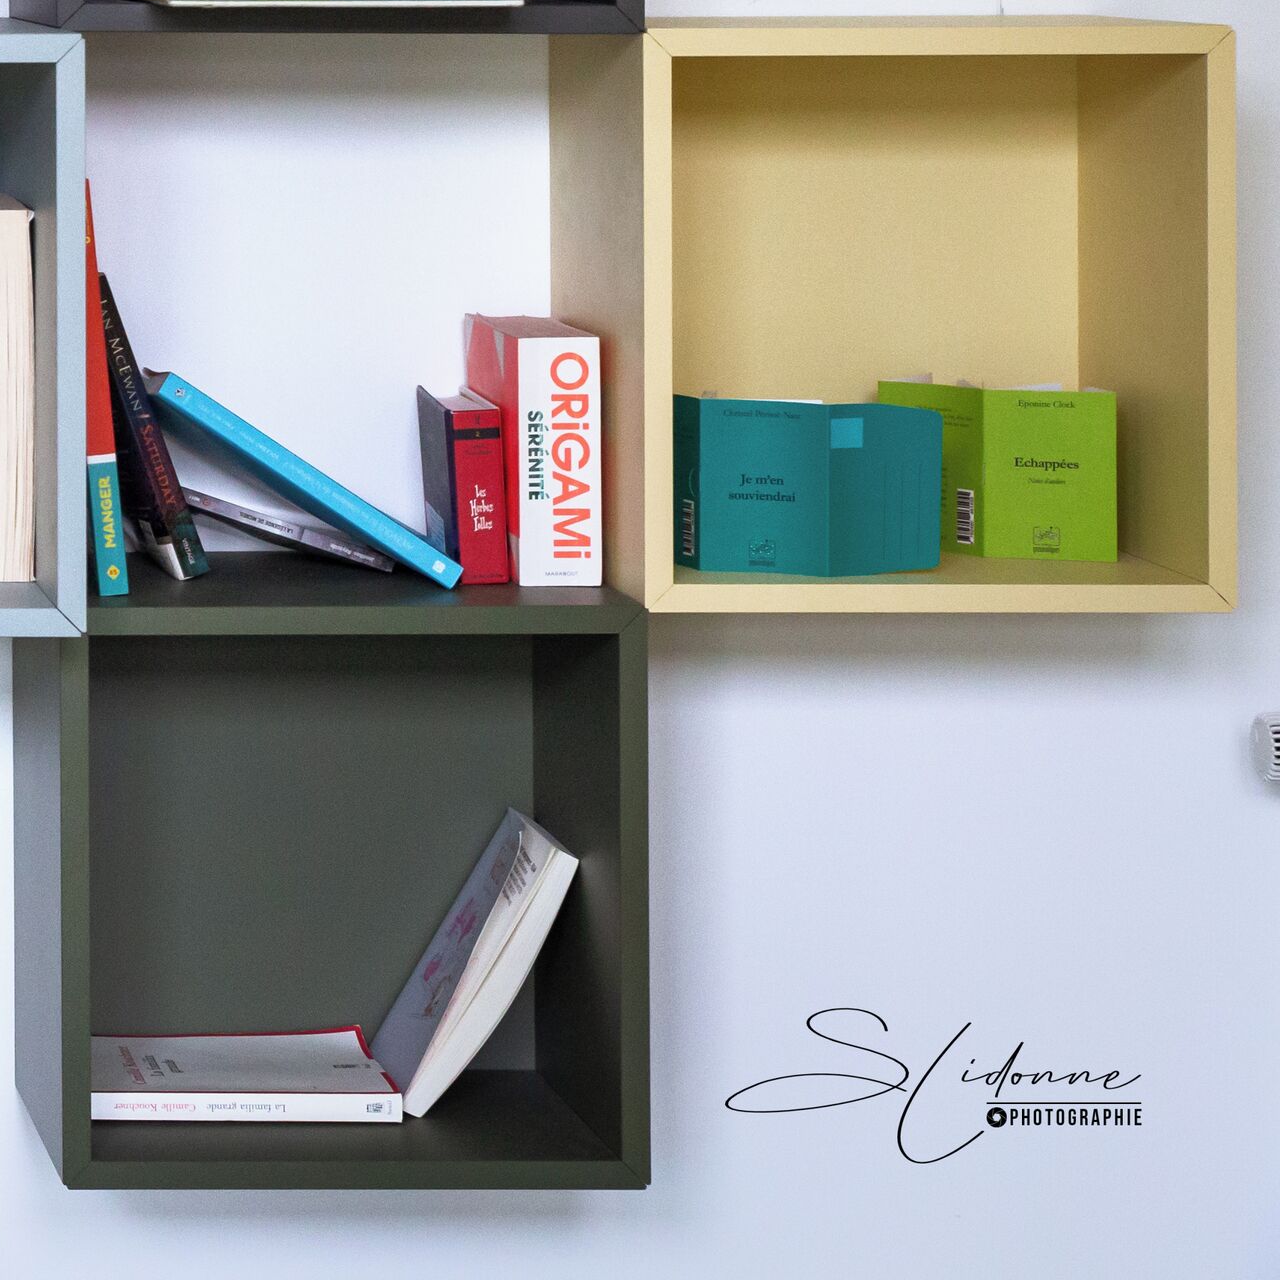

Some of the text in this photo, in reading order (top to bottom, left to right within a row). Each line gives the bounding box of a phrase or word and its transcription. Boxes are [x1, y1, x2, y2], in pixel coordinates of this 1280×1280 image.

[99, 299, 113, 331] IAN
[528, 410, 550, 501] SÉRÉNITÉ
[142, 424, 178, 506] SATURDAY
[1014, 457, 1080, 471] Echappées
[740, 474, 785, 487] Je m'en
[728, 489, 796, 503] souviendrai
[103, 475, 117, 549] MANGER
[470, 499, 494, 517] Herbes
[473, 517, 493, 533] Folles
[113, 1102, 196, 1112] Camille Kouchner
[206, 1103, 286, 1112] La familia grande
